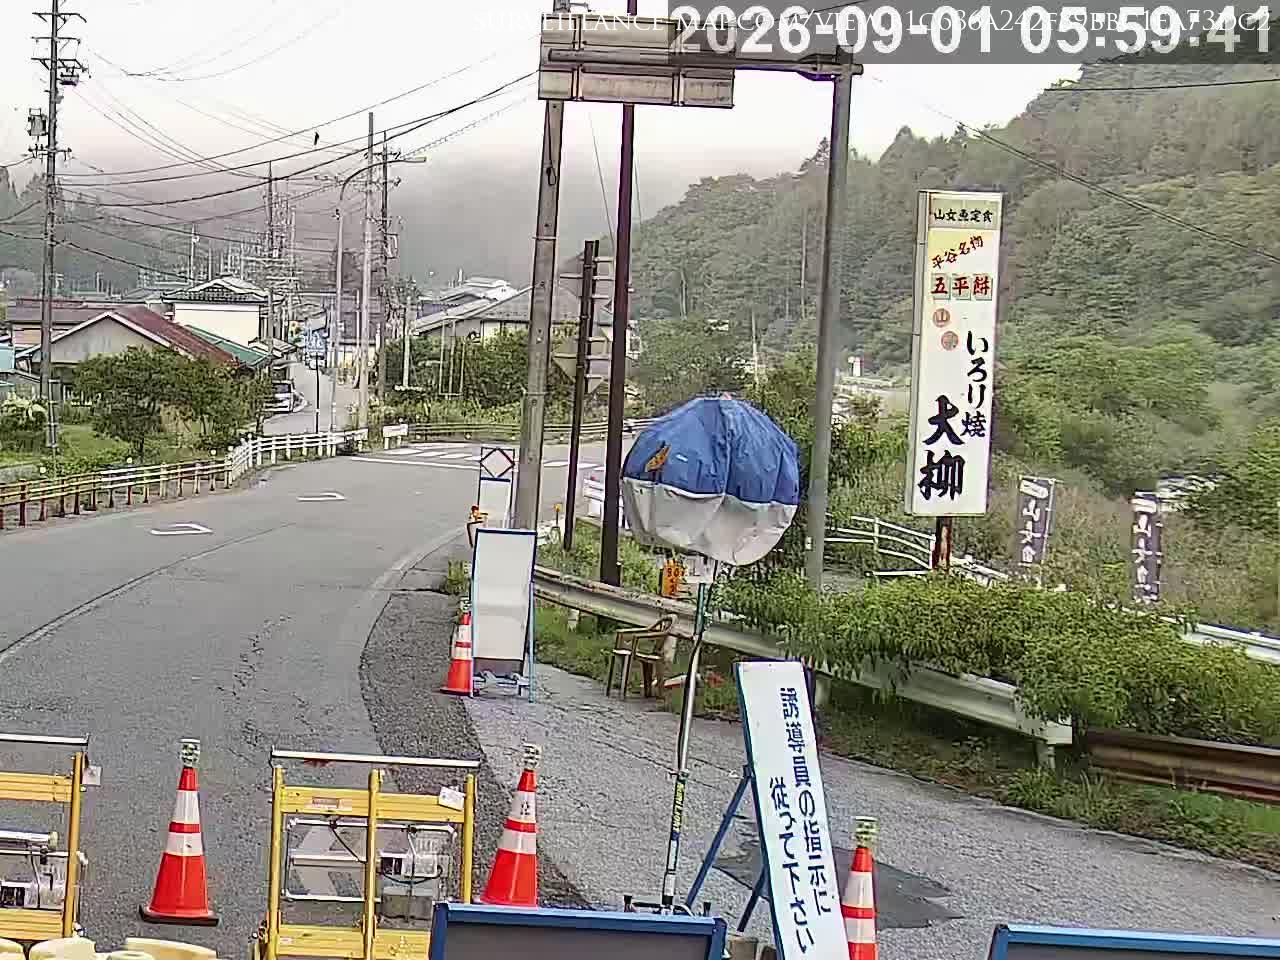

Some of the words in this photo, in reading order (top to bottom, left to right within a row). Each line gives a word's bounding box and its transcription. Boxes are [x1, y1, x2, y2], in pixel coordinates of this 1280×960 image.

[931, 235, 984, 269] 平谷名物
[931, 276, 990, 296] 五平餅
[961, 330, 989, 438] いろり焼
[917, 395, 966, 501] 大柳
[779, 687, 832, 916] 誘導員の指示に
[769, 775, 815, 954] 従って下さい
